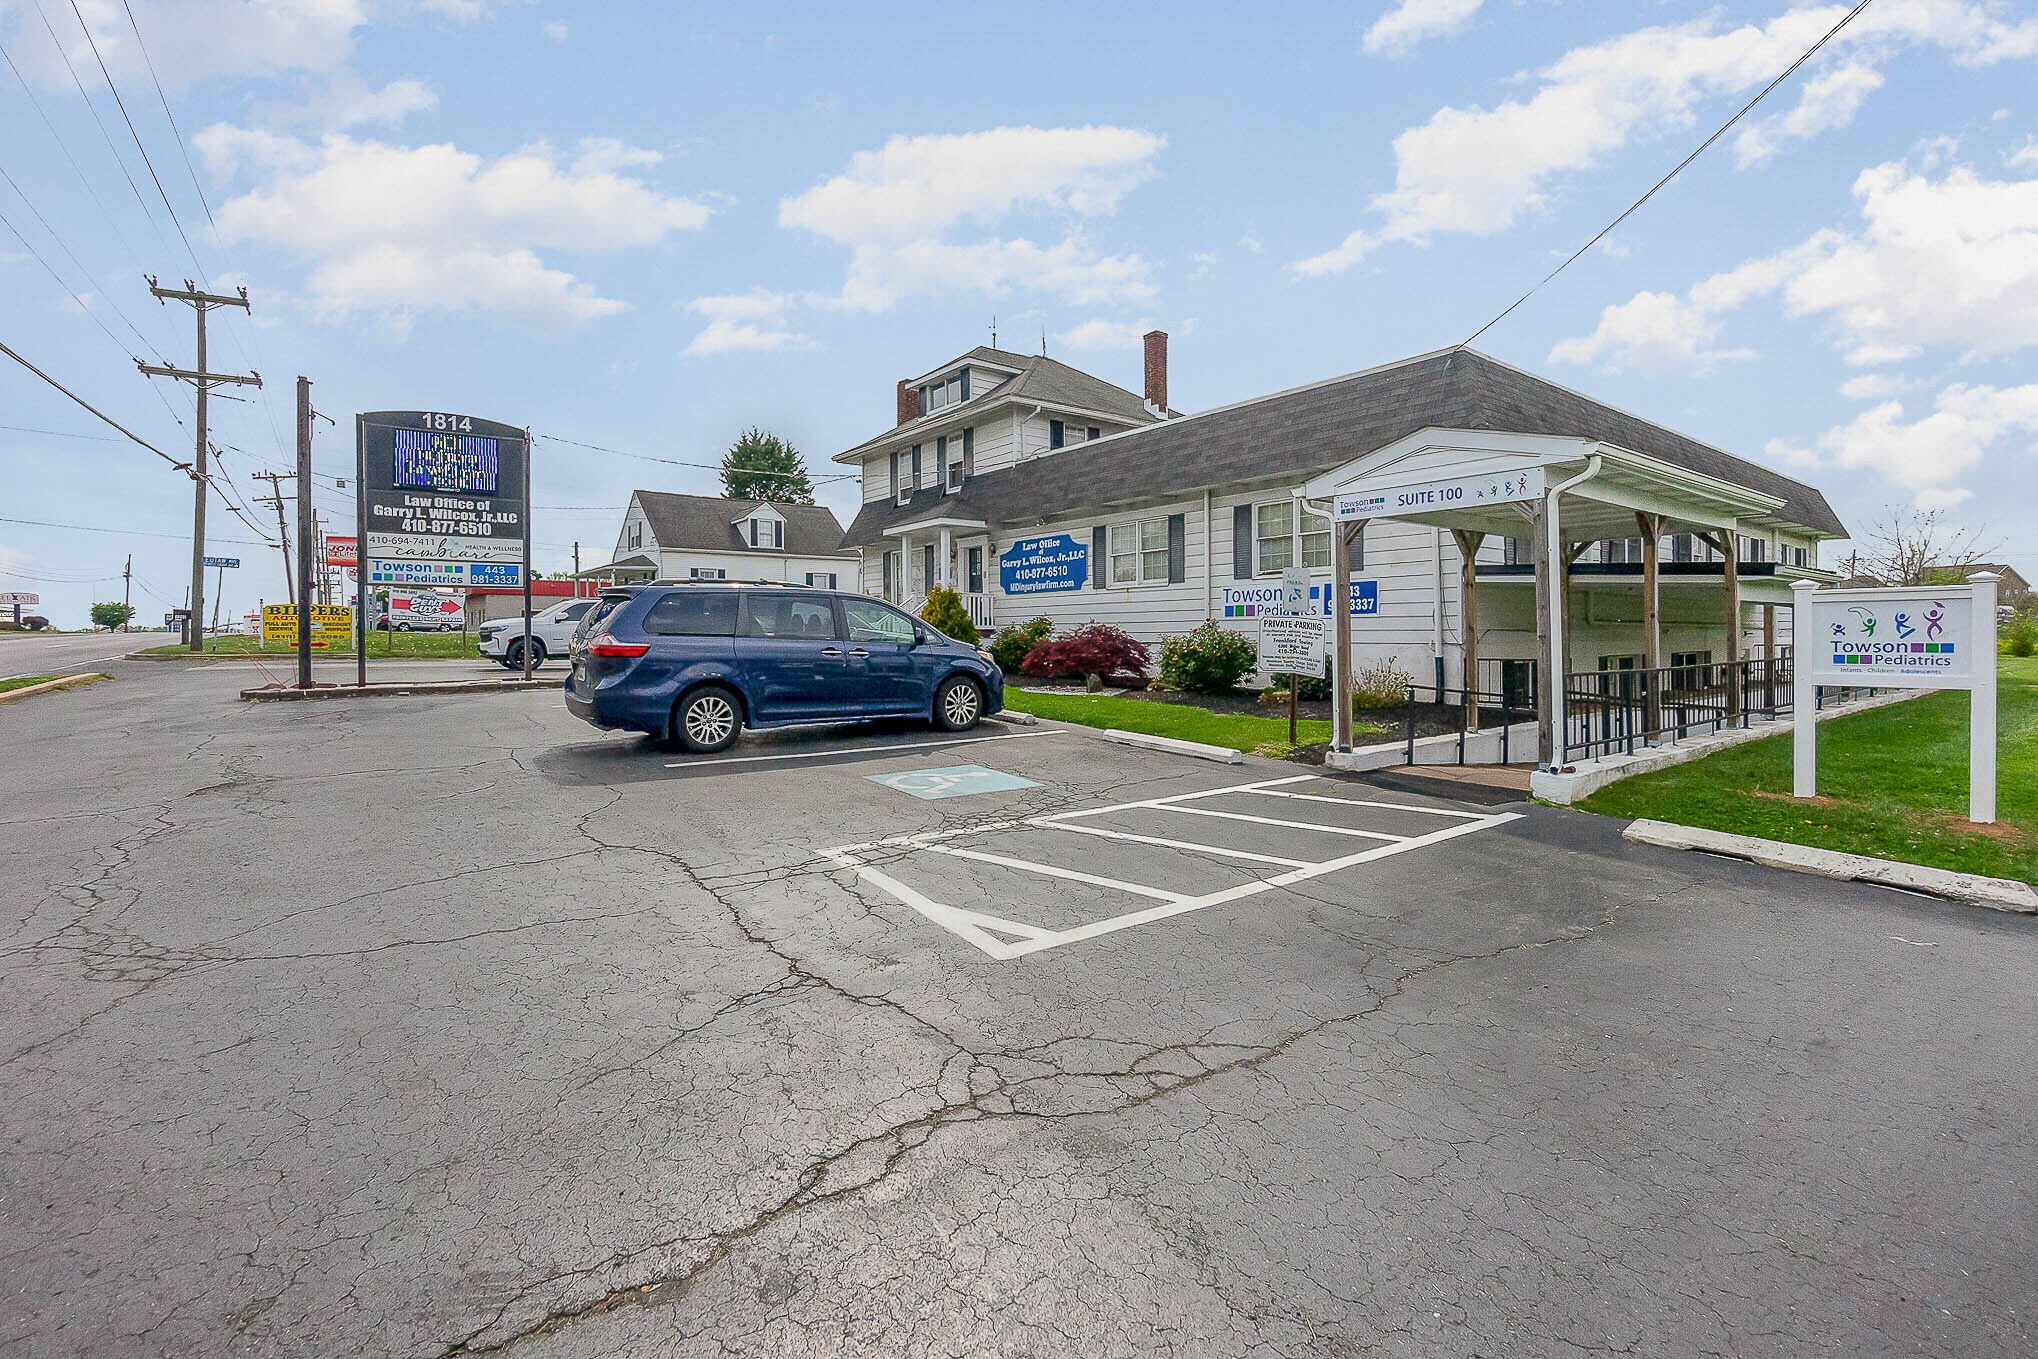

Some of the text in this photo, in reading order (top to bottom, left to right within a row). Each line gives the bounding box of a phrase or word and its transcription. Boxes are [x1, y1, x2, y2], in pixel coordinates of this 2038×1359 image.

[422, 412, 473, 433] 1814
[404, 495, 491, 511] Law Office of
[1339, 498, 1369, 508] Towson
[1398, 487, 1463, 507] SUITE 100
[373, 504, 413, 518] Garry
[416, 508, 426, 519] L.
[429, 508, 479, 522] Wilcox,
[1356, 504, 1384, 513] Pediatrics
[401, 519, 492, 536] 410-877-6510
[369, 536, 436, 546] 410-694-7411
[1022, 539, 1061, 551] Law Office
[372, 560, 433, 572] Towson
[1001, 559, 1021, 568] Garry
[1029, 555, 1056, 565] Wilcox,
[484, 566, 506, 575] 443
[1015, 565, 1068, 580] 410-877-6510
[405, 574, 464, 584] Pediatrics
[472, 575, 518, 584] 981-3337
[1223, 587, 1283, 603] Towson
[1263, 620, 1322, 631] PRIVATE PARKING
[1830, 640, 1908, 653] Towson
[1875, 654, 1951, 666] Pediatrics
